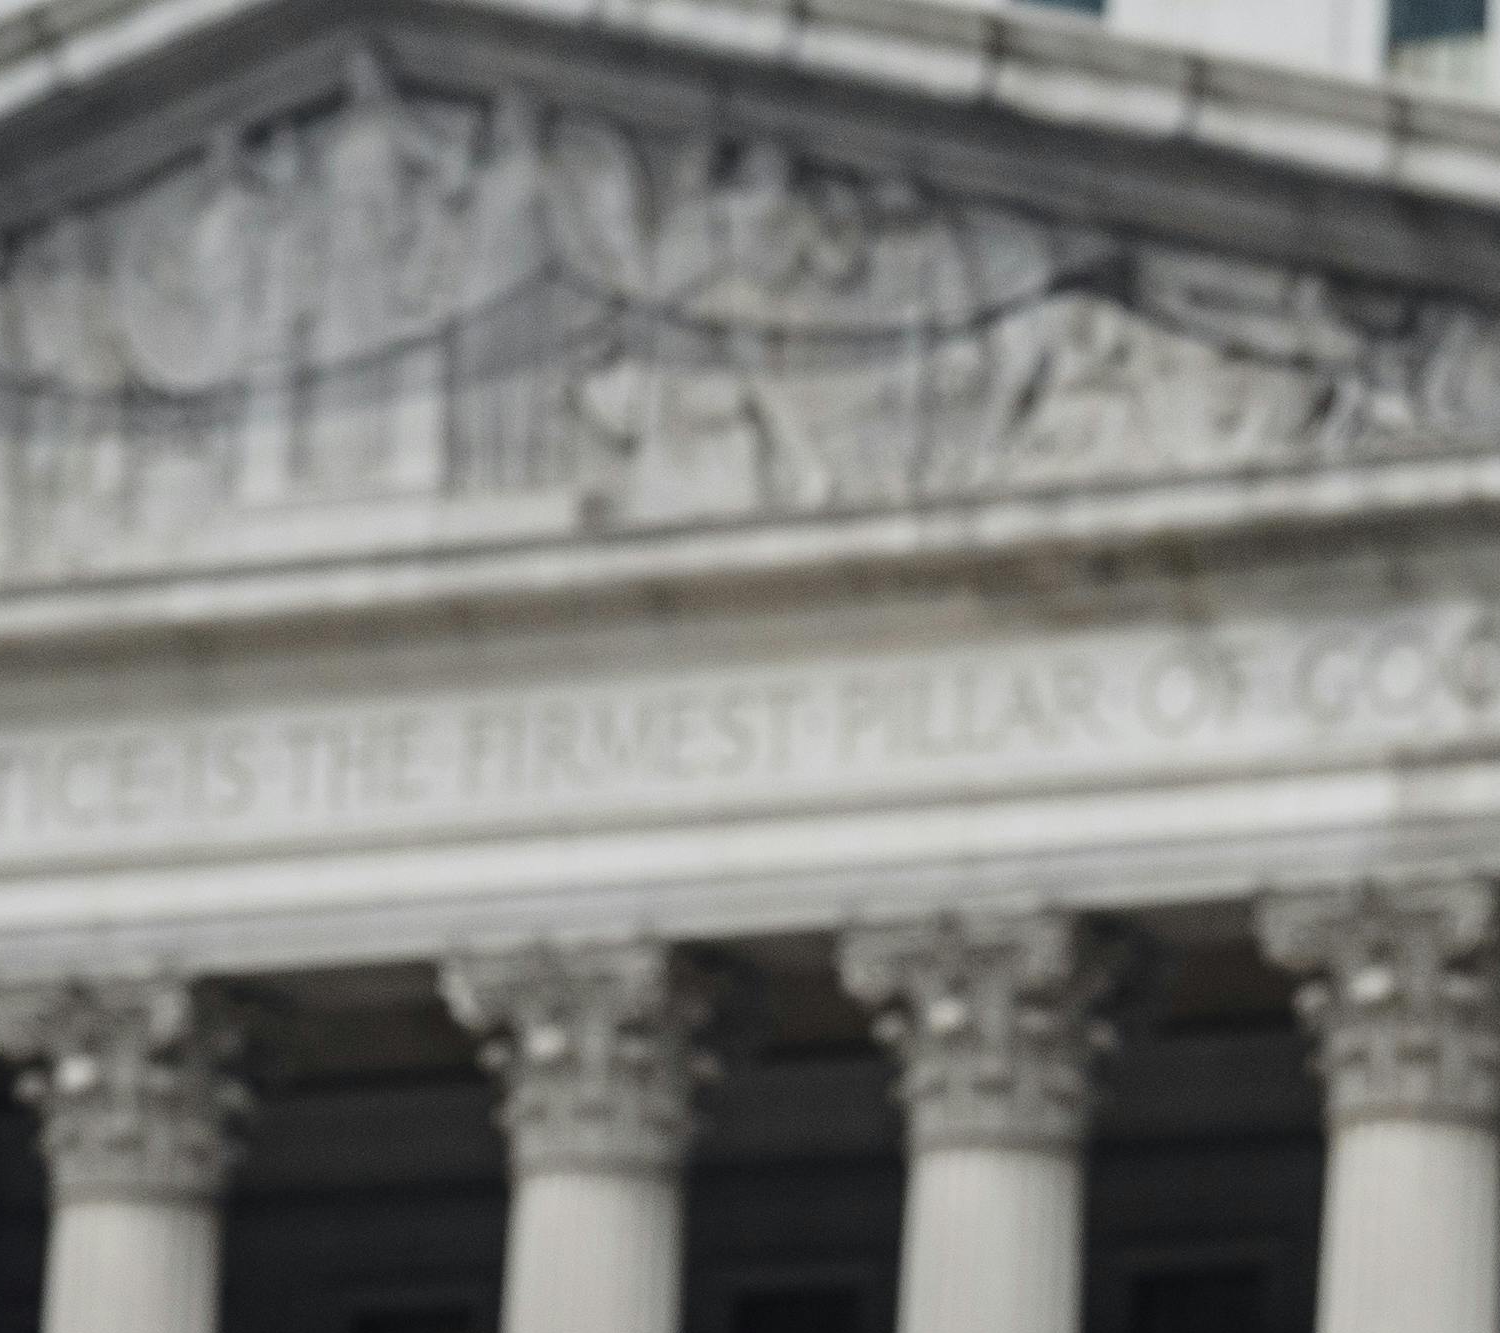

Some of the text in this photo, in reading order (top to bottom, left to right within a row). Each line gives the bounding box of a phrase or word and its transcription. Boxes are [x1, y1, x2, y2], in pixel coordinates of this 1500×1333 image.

[182, 727, 259, 822] IS
[281, 712, 430, 811] THE
[461, 677, 808, 797] FIRMEST
[836, 646, 1112, 763] PILLAR
[1137, 638, 1248, 742] OF
